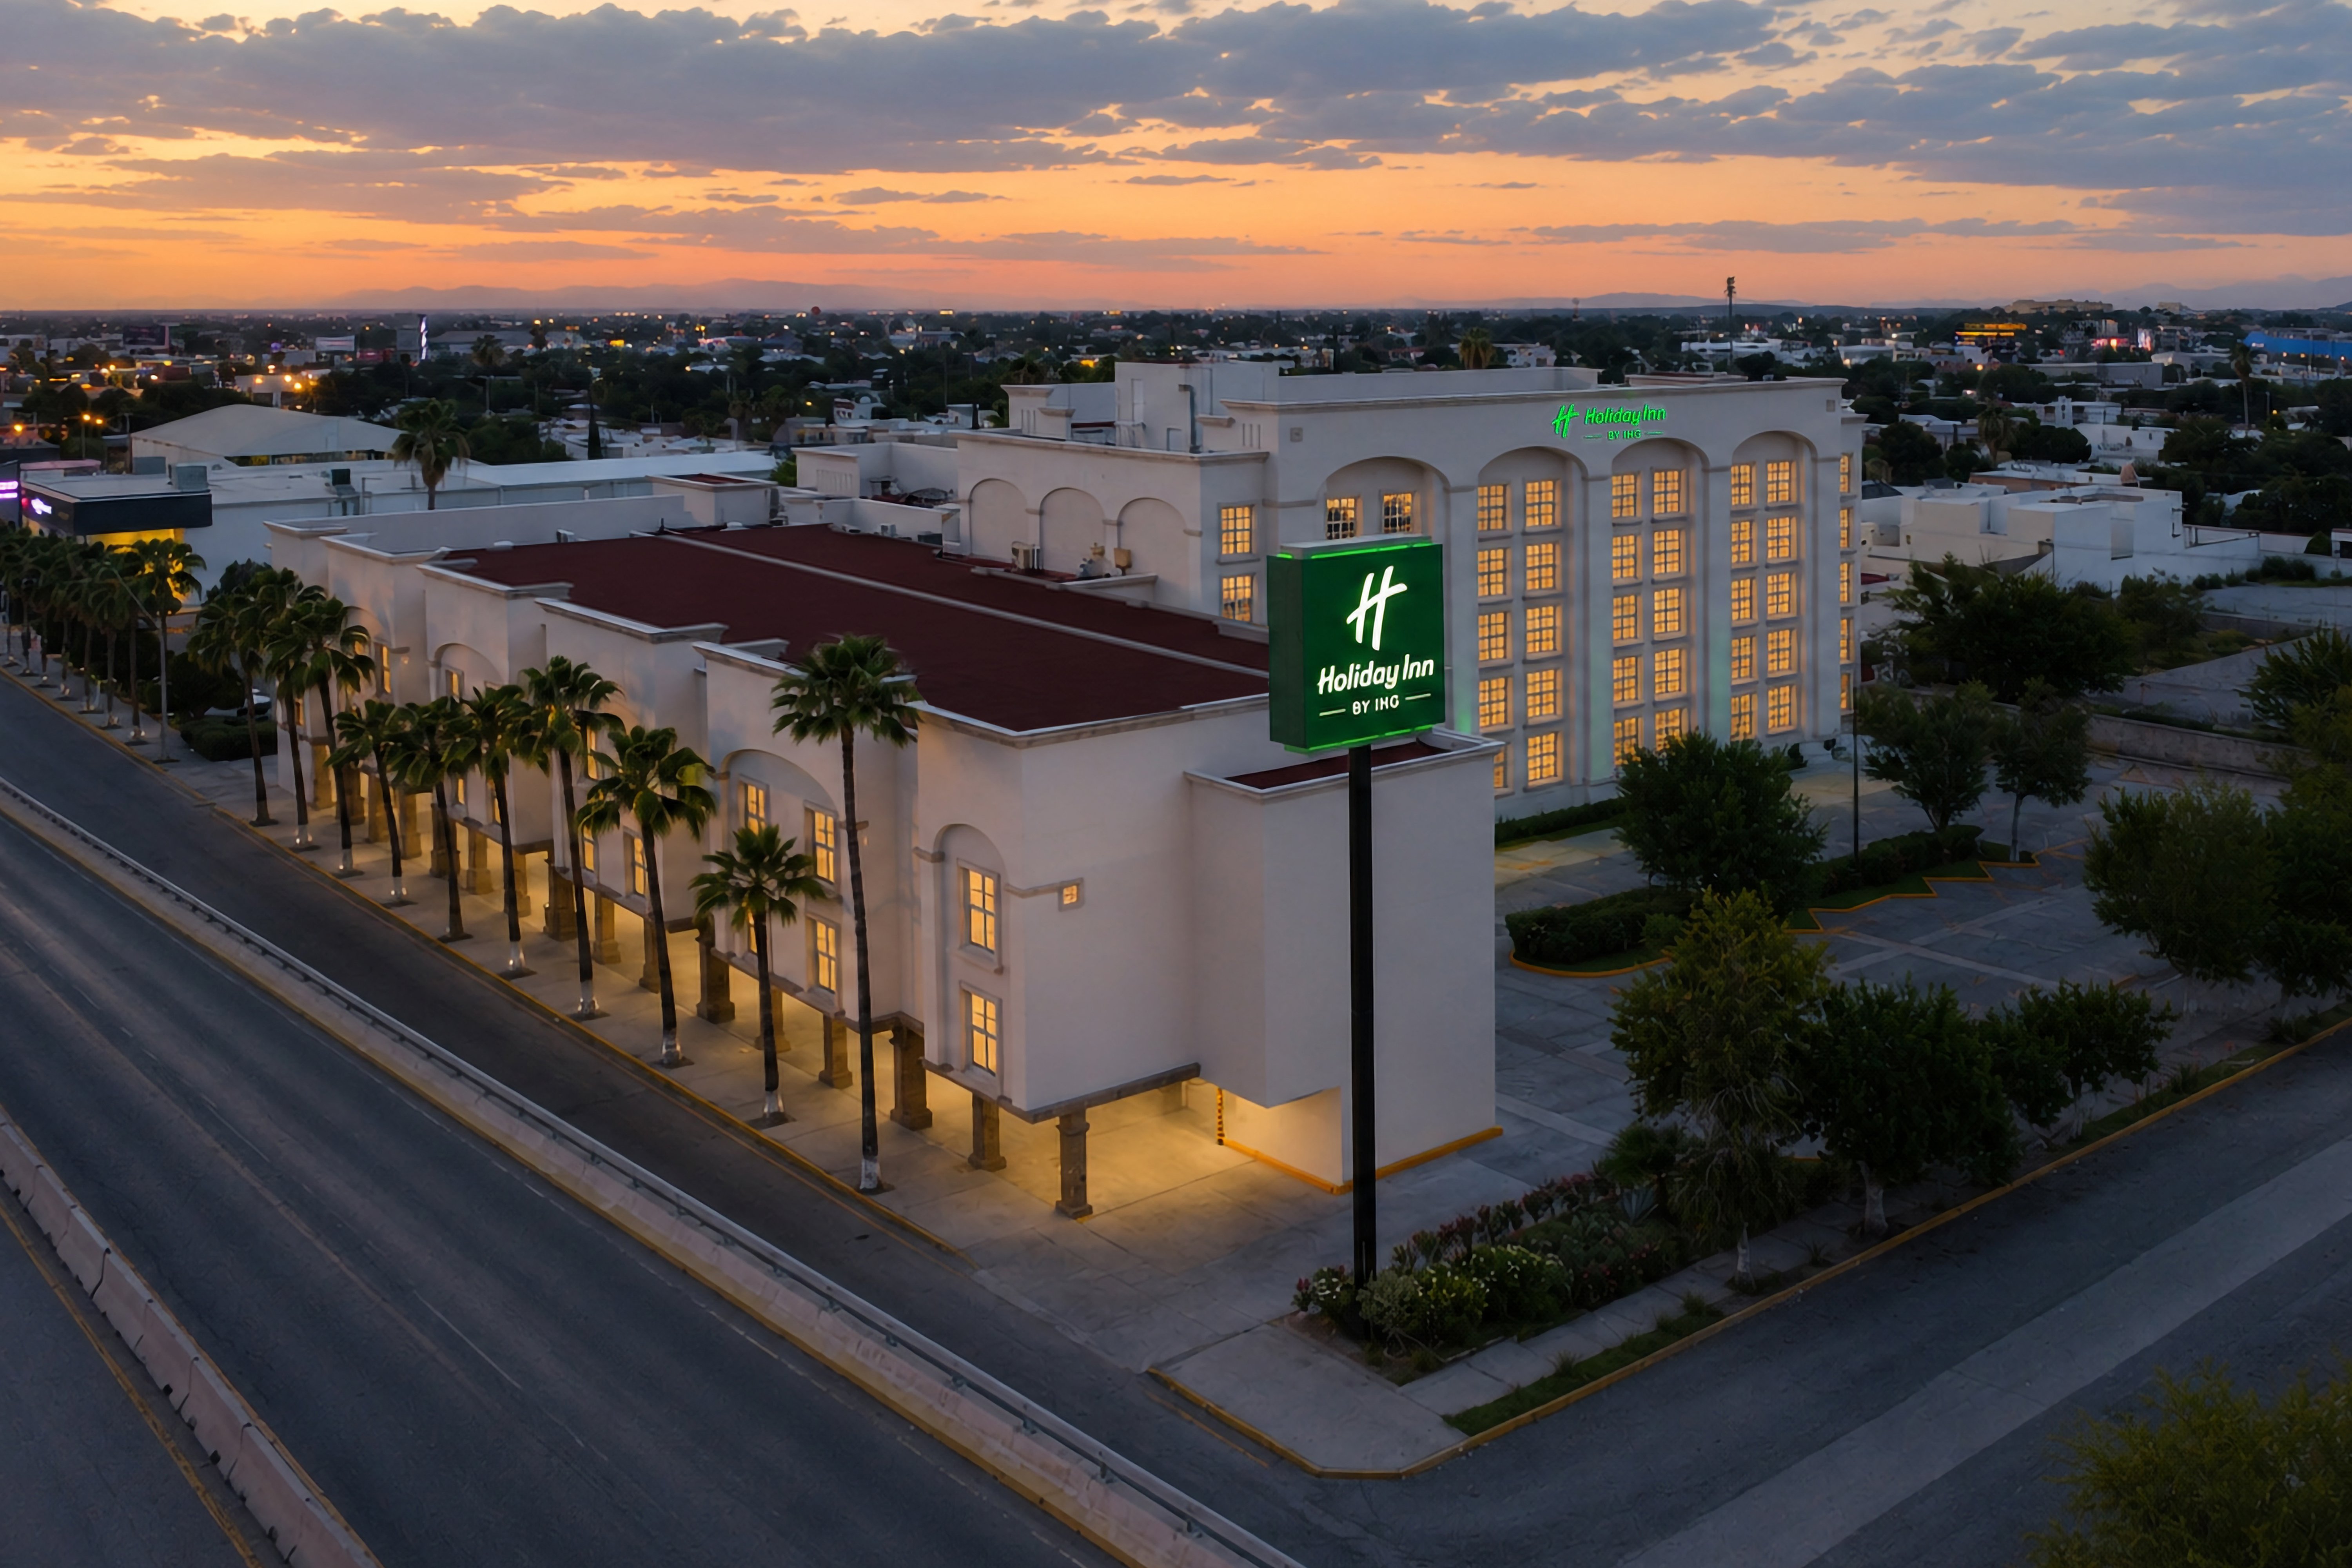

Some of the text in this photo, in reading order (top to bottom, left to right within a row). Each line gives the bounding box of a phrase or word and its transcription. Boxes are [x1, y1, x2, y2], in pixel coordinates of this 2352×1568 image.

[1584, 404, 1666, 426] Holiday Inn
[1608, 430, 1641, 440] BY IHG
[1317, 654, 1434, 694] Holiday Inn
[1352, 700, 1370, 715] BY
